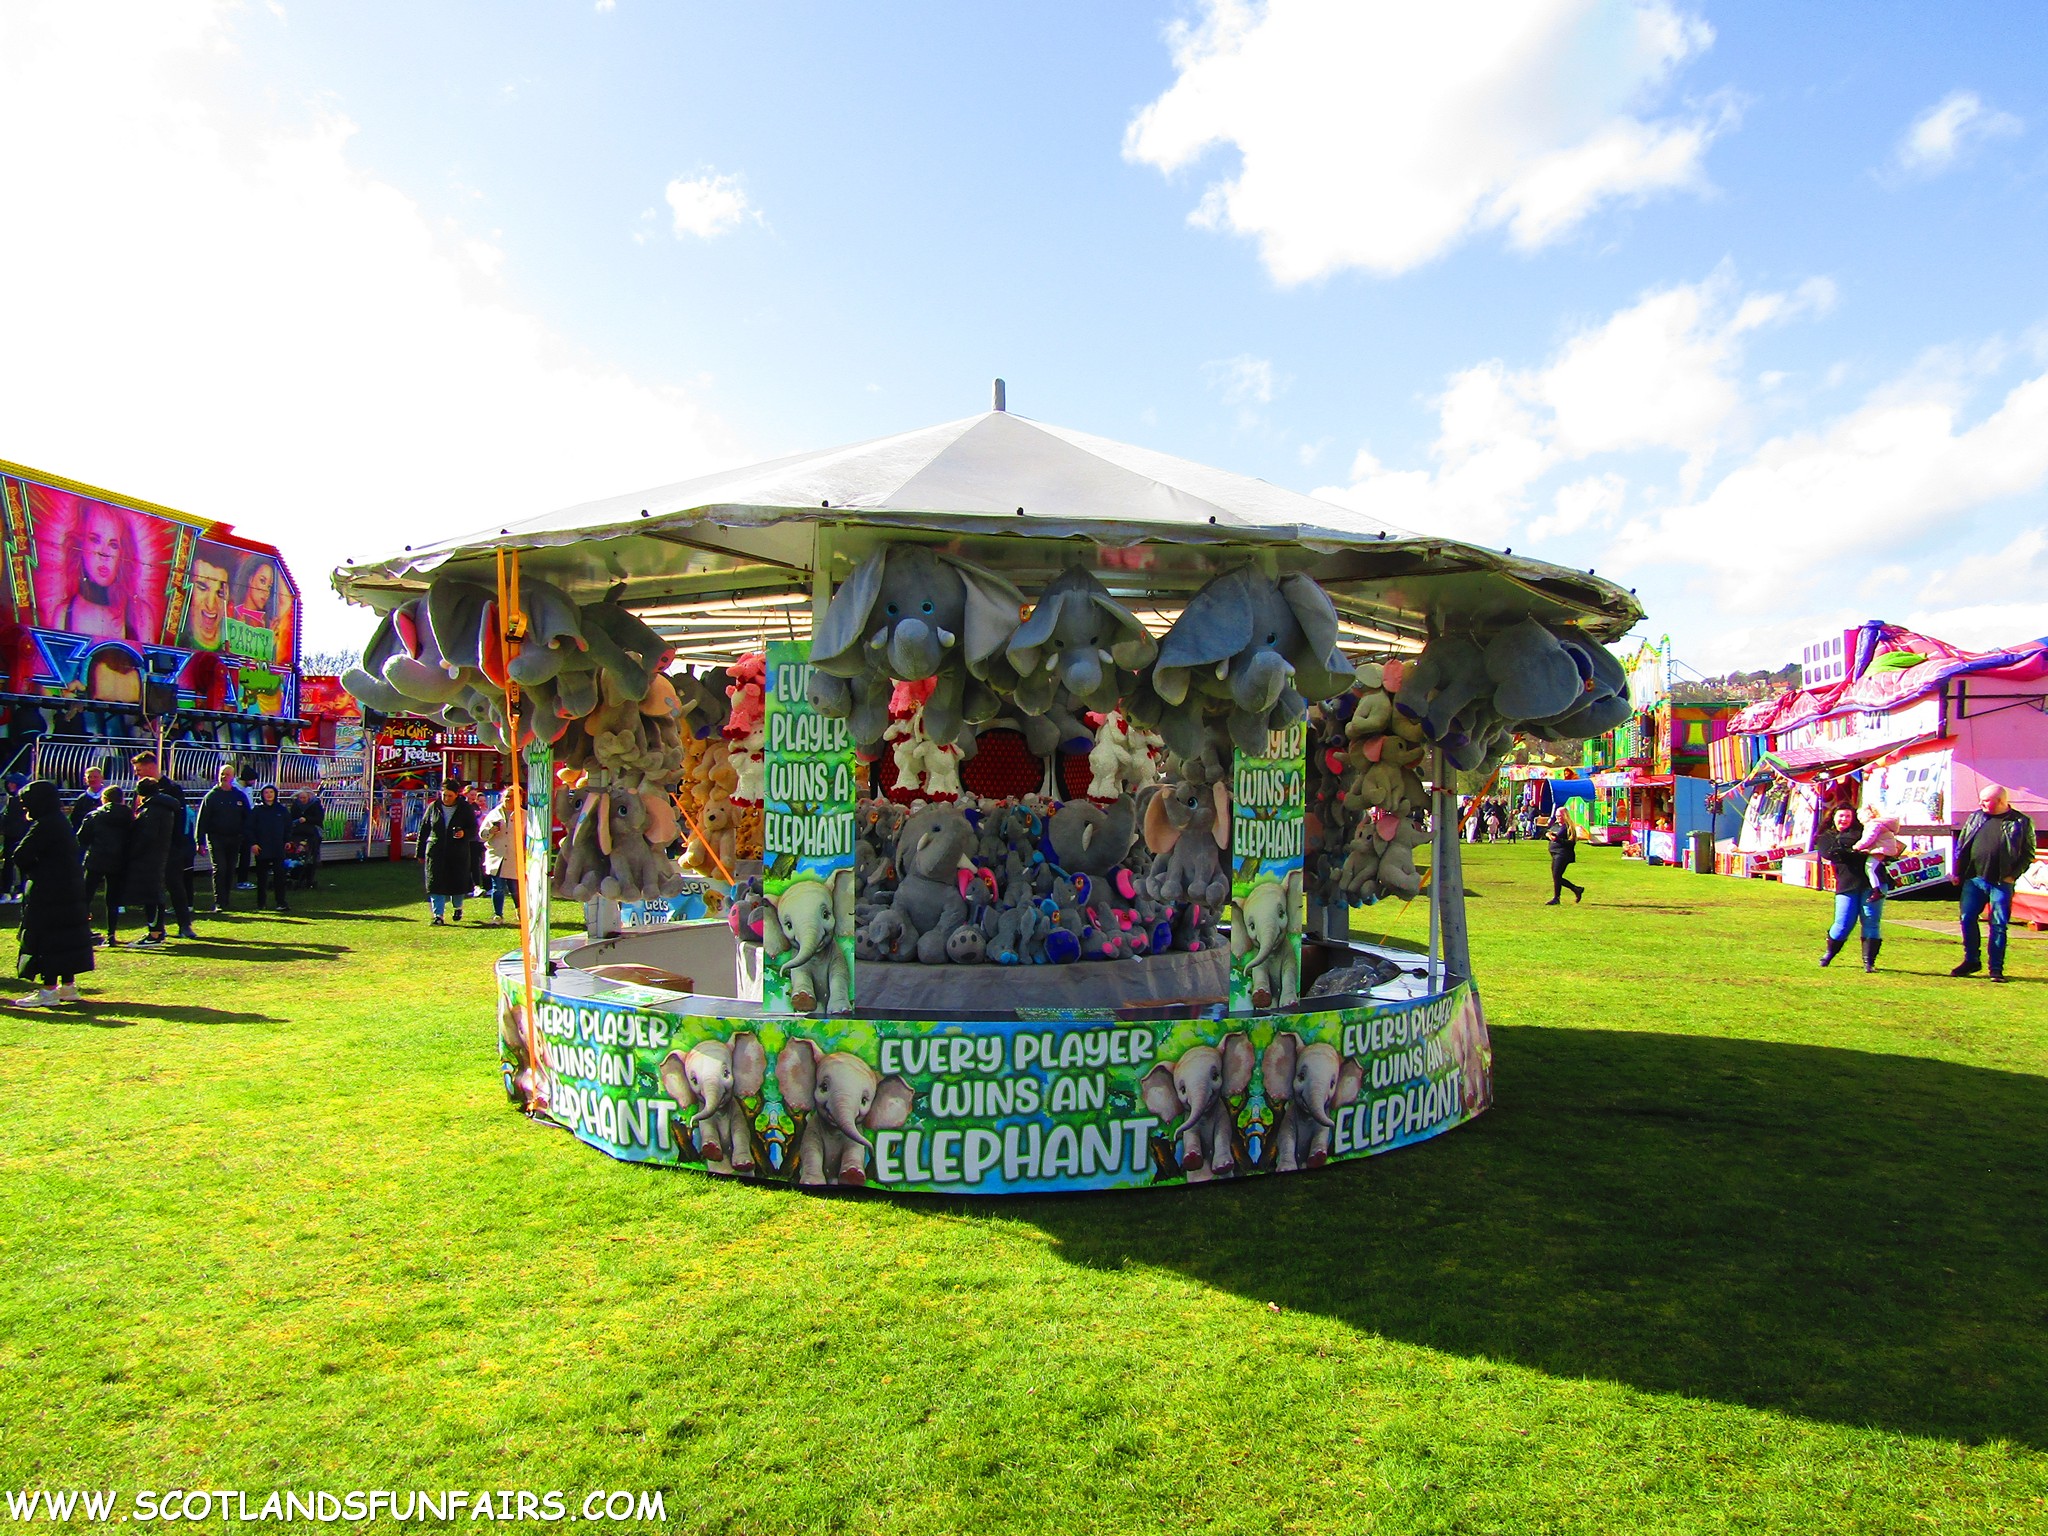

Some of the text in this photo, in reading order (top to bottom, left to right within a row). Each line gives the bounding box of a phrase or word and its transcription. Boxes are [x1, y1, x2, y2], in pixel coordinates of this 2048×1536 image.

[229, 622, 269, 658] PARTY
[772, 713, 848, 752] PLAYER
[770, 762, 849, 801] WINS A
[1239, 769, 1300, 806] WINS A
[765, 811, 855, 856] ELEPHANT
[1234, 817, 1304, 859] ELEPHANT
[579, 1008, 670, 1049] PLAYER
[1343, 996, 1453, 1057] EVERY PLAYER
[600, 1051, 635, 1086] AN
[881, 1029, 1154, 1074] EVERY PLAYER
[1371, 1036, 1443, 1090] WINS AN
[930, 1074, 1105, 1118] WINS AN
[1334, 1067, 1460, 1154] ELEPHANT
[875, 1117, 1159, 1184] ELEPHANT
